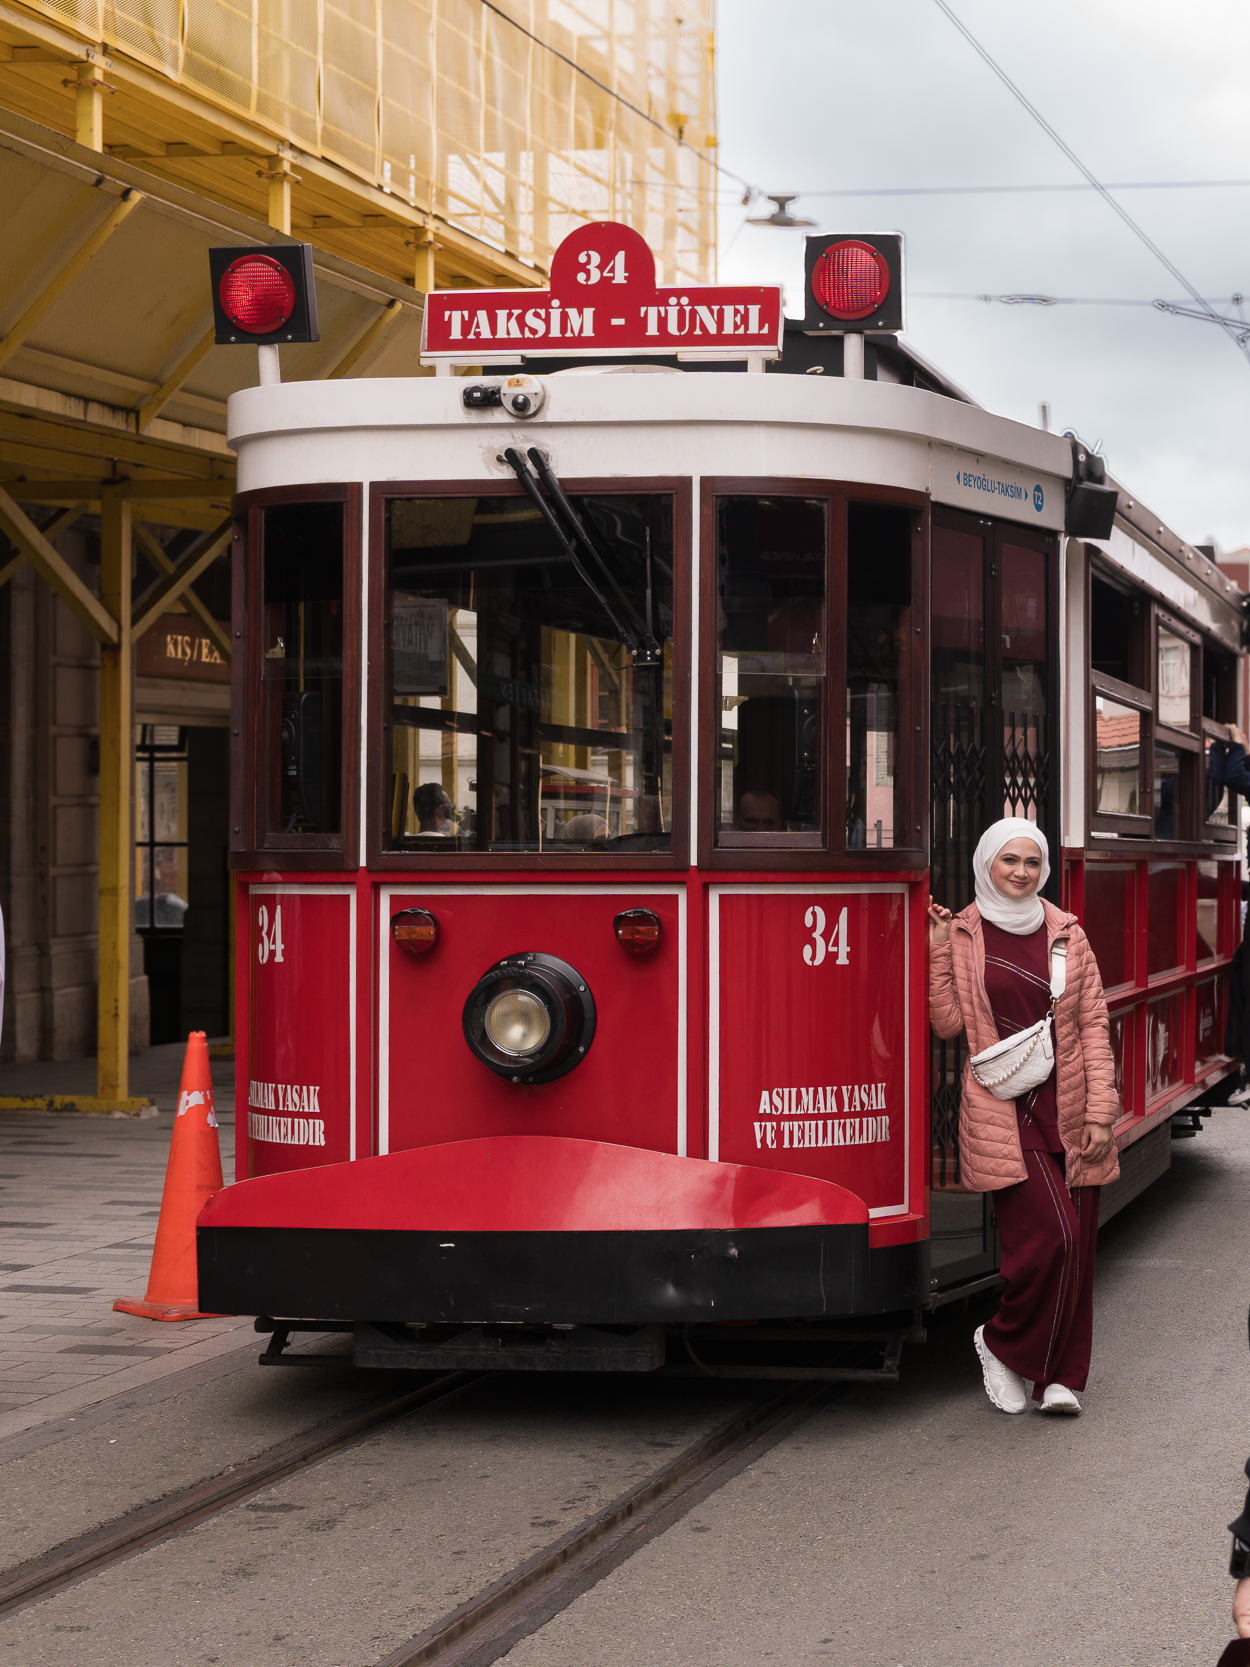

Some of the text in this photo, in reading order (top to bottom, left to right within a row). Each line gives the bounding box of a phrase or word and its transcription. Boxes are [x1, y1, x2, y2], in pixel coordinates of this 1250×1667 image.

[576, 250, 629, 286] 34
[444, 299, 596, 340] TAKSİM
[640, 296, 769, 336] TÜNEL
[1033, 491, 1043, 506] T2
[258, 904, 285, 965] 34
[803, 905, 851, 966] 34
[248, 1080, 321, 1113] SILMAK YASAK
[758, 1082, 887, 1116] ASILMAK YASAK
[252, 1113, 326, 1146] TEHLIKELIDIR
[753, 1115, 891, 1149] VE TEHLIKELIDIR
